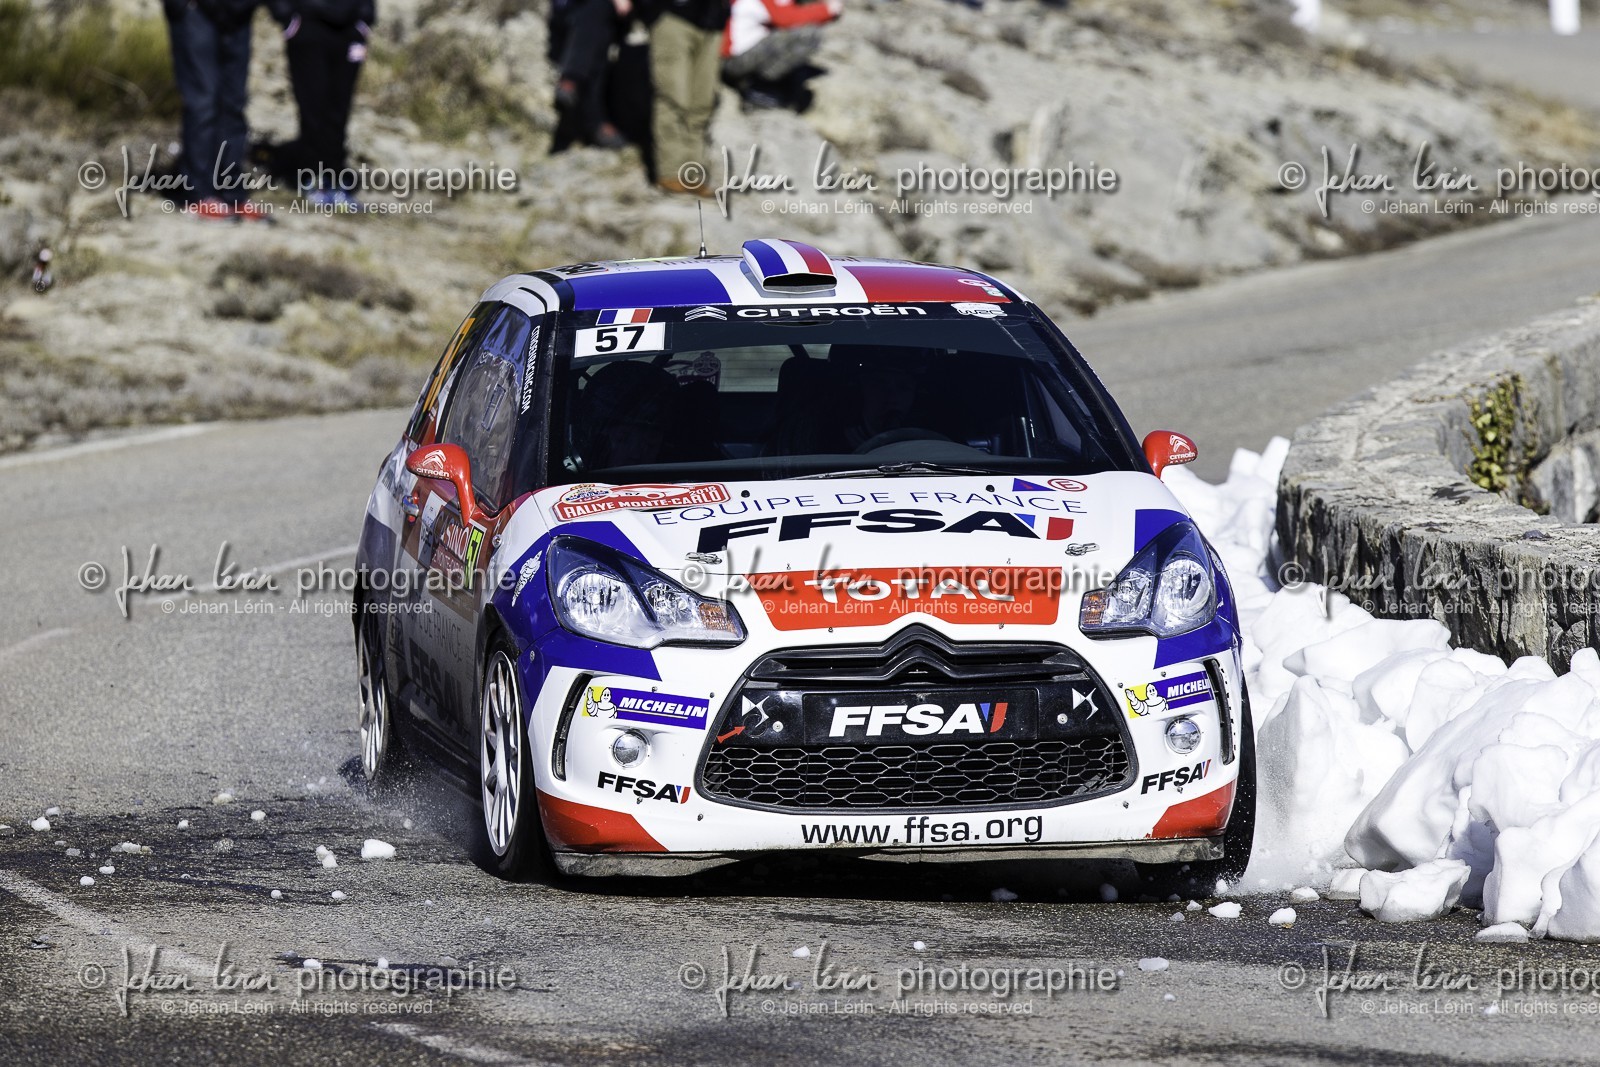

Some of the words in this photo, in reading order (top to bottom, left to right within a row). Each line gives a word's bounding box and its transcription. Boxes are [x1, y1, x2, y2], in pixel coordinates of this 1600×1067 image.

[594, 325, 646, 353] 57
[563, 502, 616, 519] RALLYE
[619, 490, 723, 508] MONTE-CARLO
[653, 494, 821, 526] EQUIPE
[834, 492, 896, 505] DE
[909, 491, 1088, 514] FRANCE
[696, 508, 1042, 553] FFSA
[803, 576, 1016, 604] TOTAL
[618, 696, 708, 718] MICHELIN
[828, 702, 986, 738] FFSA
[597, 771, 680, 804] FFSA
[1140, 763, 1205, 795] FFSA
[801, 814, 1044, 843] www.ffsa.org
